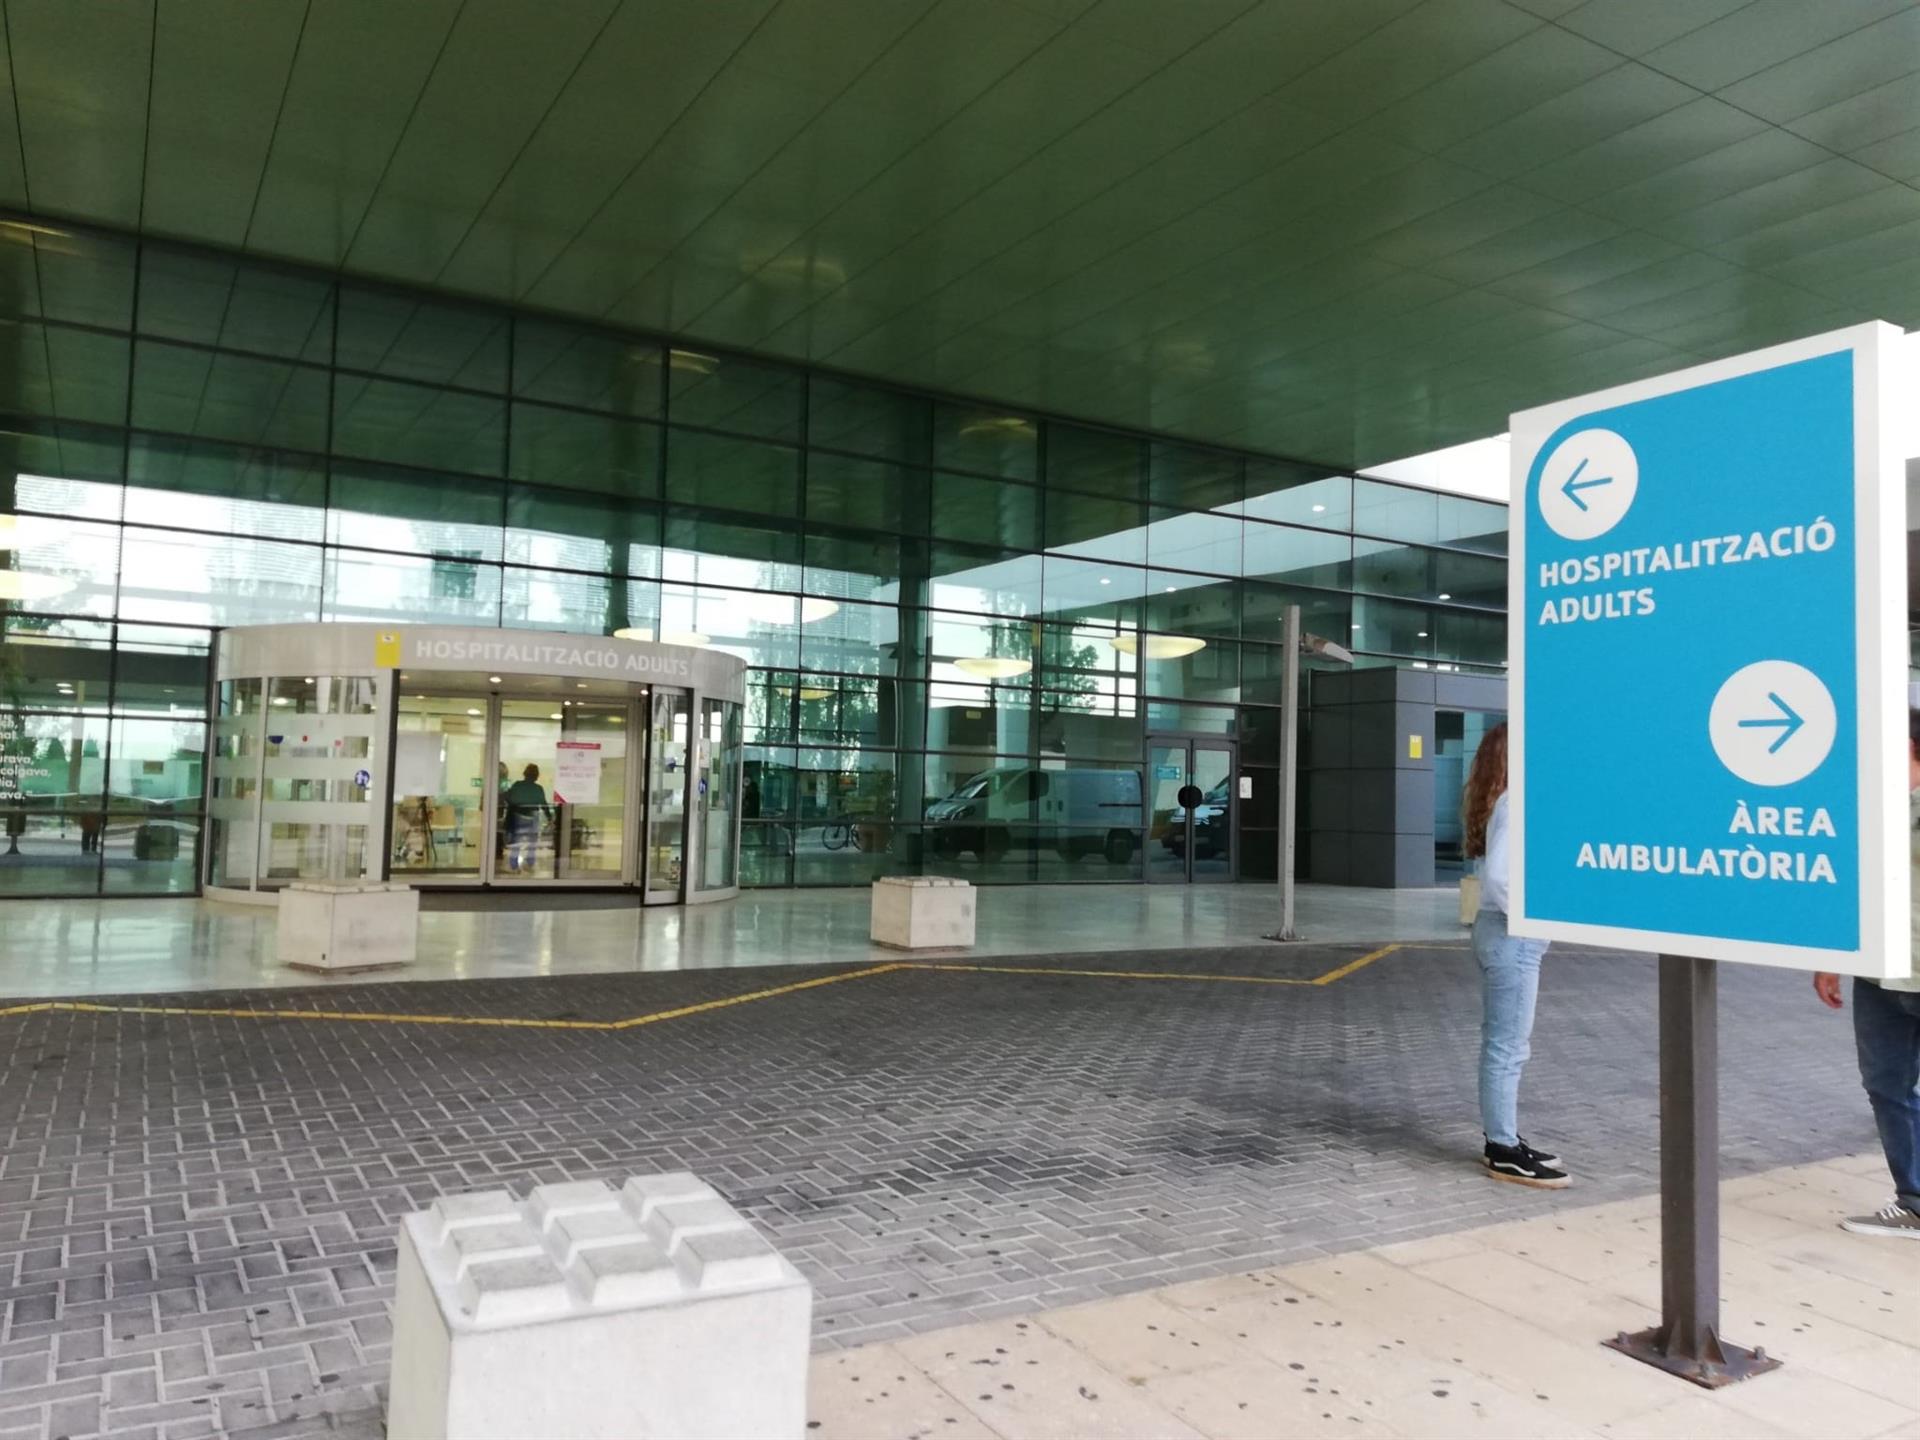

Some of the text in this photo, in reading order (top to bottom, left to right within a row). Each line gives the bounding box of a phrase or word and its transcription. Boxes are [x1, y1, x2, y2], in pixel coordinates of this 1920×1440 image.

[1539, 515, 1837, 588] HOSPITALITZACIÓ
[1538, 587, 1656, 626] ADULTS
[415, 639, 689, 676] HOSPITALITZACIÓ ADULTS
[1728, 799, 1838, 838] ÀREA
[1575, 843, 1838, 884] AMBULATÒRIA
